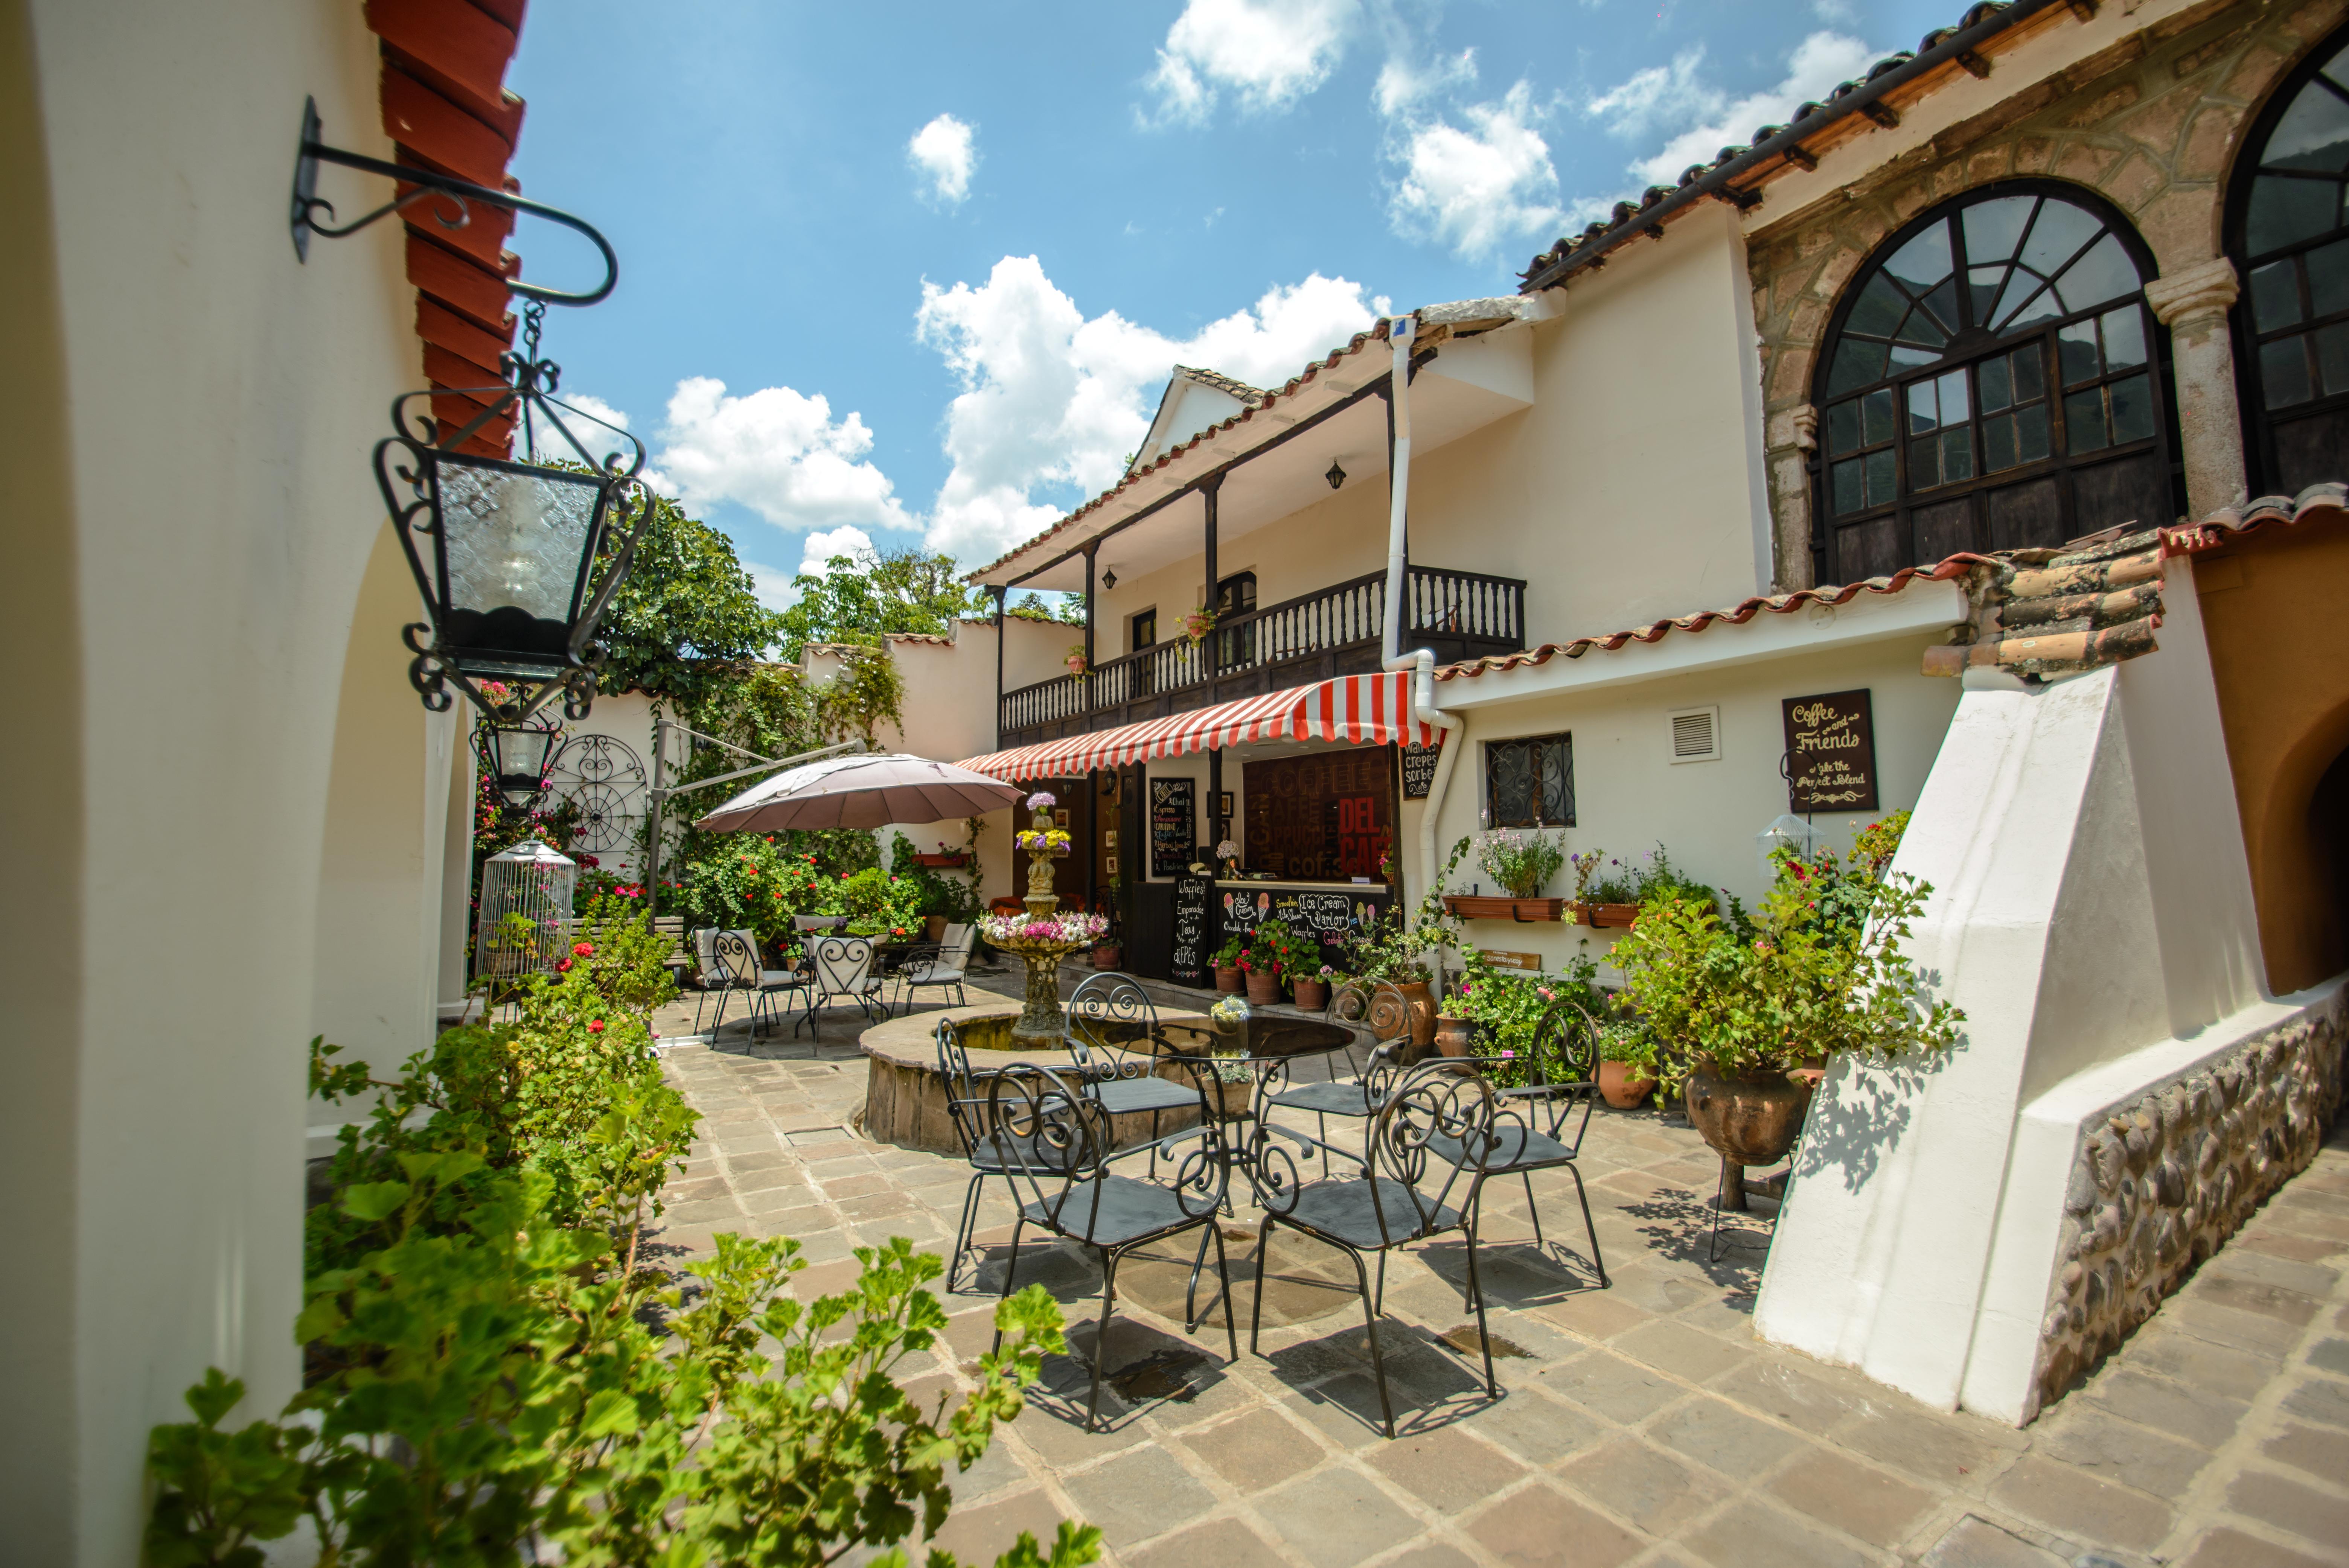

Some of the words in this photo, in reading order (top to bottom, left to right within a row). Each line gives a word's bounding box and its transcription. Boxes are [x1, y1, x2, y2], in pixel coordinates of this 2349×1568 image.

[1793, 703, 1838, 727] Coffee
[1831, 715, 1848, 730] and
[1796, 729, 1860, 754] Friends
[1406, 755, 1437, 768] crepes
[1833, 760, 1850, 771] the
[1261, 762, 1371, 798] COFFEE
[1832, 773, 1866, 785] Blend
[1155, 804, 1175, 815] Espresso
[1340, 797, 1380, 834] DEL
[1164, 860, 1184, 871] Pastries
[1179, 880, 1203, 900] Waffles
[1235, 892, 1250, 904] Ice
[1277, 896, 1298, 908] Smoothies
[1301, 895, 1316, 909] Ice
[1318, 896, 1346, 910] Cream
[1235, 904, 1256, 919] Cream
[1315, 911, 1344, 926] Parlor
[1178, 919, 1194, 936] Teas
[1224, 921, 1241, 932] Chocolate
[1290, 926, 1315, 943] Waffles
